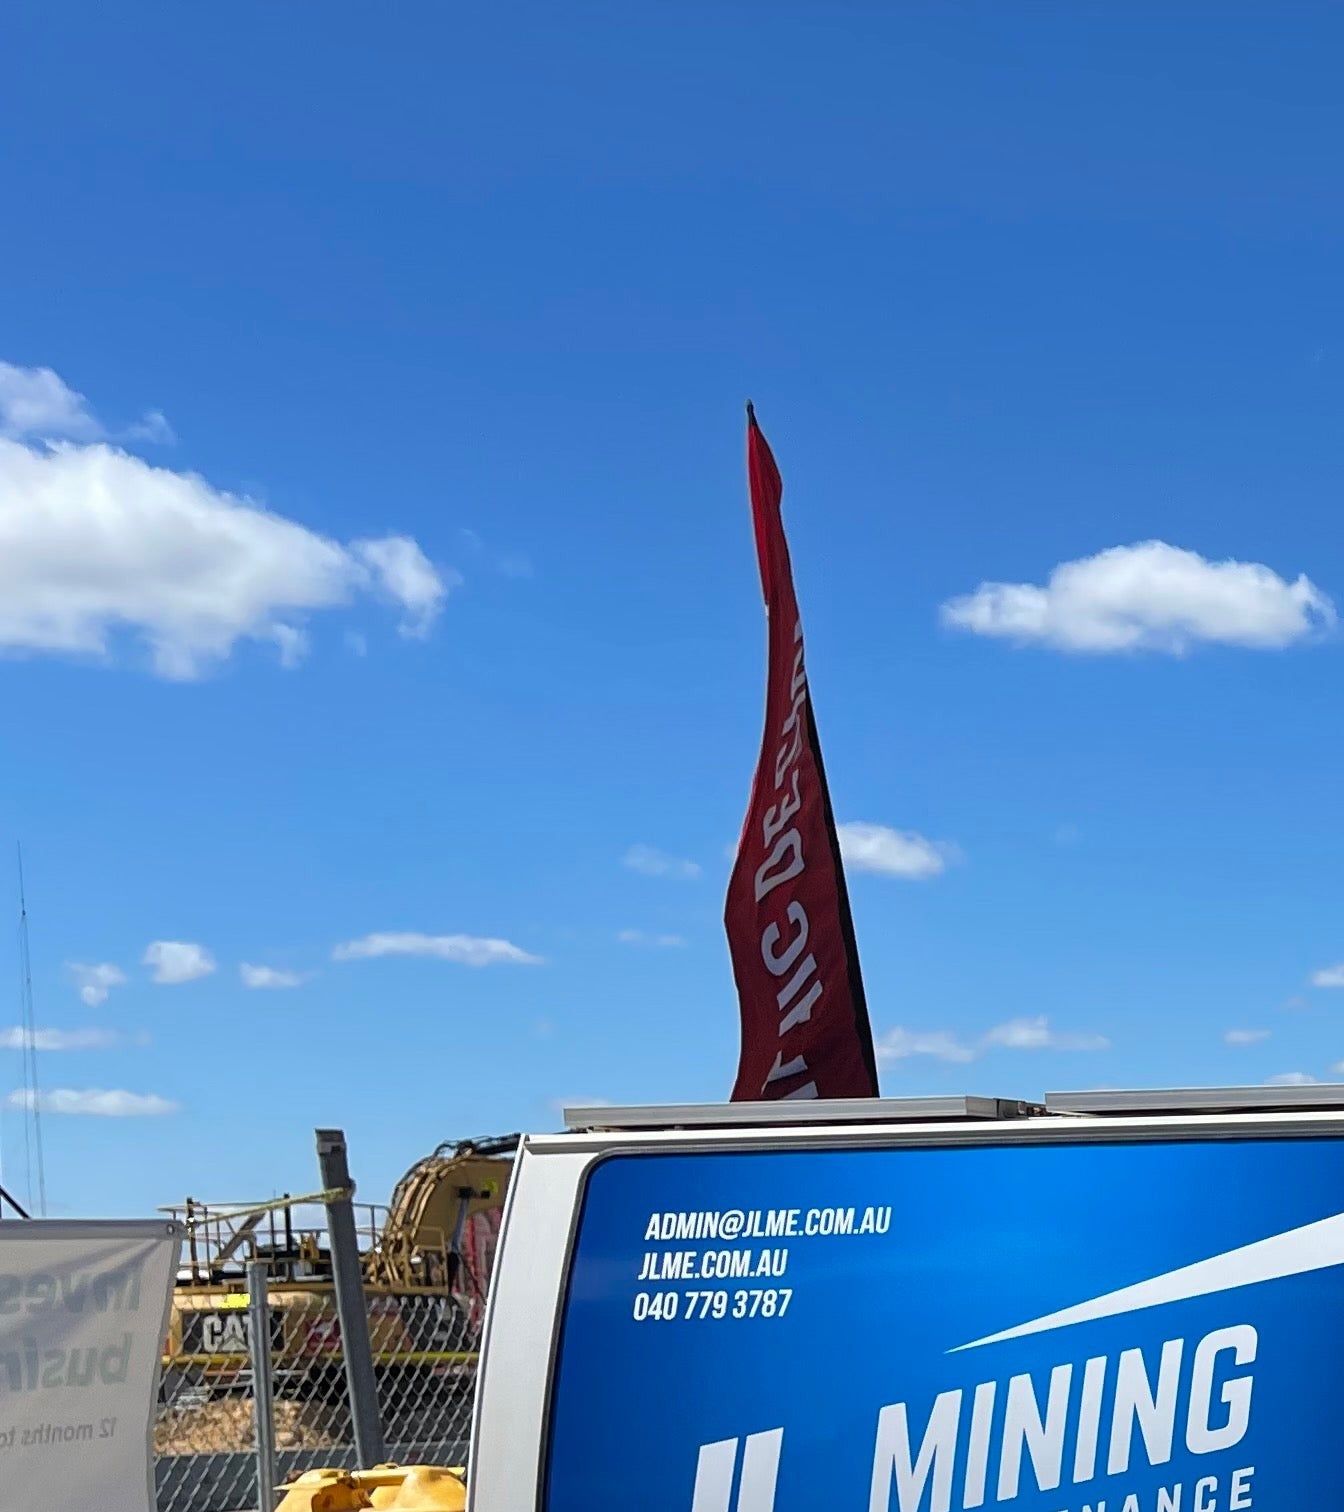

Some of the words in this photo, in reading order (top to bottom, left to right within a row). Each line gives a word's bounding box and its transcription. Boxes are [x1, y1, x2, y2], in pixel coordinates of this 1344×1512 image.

[644, 1207, 891, 1241] ADMIN@JLME.COM.AU
[638, 1249, 788, 1281] JLME.COM.AU
[633, 1292, 677, 1321] 040
[685, 1291, 727, 1319] 779
[732, 1289, 793, 1318] 3787
